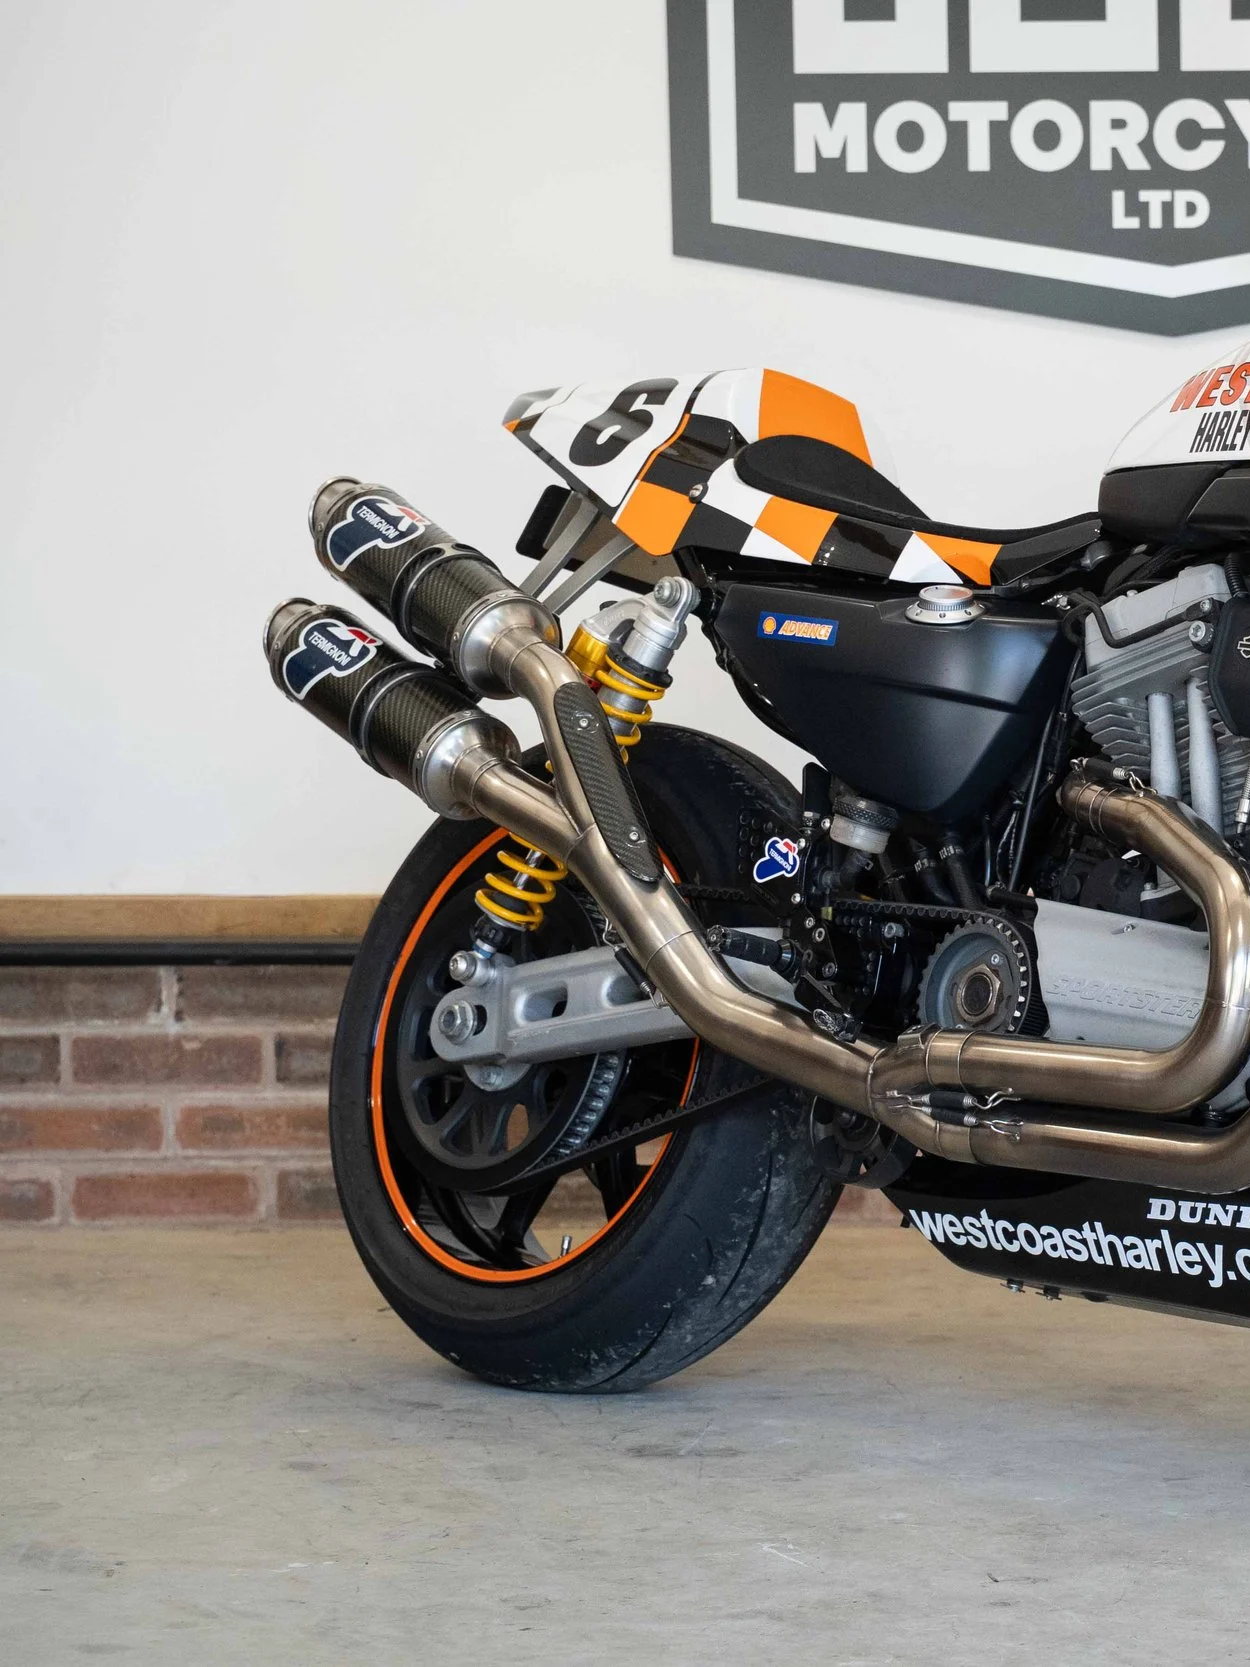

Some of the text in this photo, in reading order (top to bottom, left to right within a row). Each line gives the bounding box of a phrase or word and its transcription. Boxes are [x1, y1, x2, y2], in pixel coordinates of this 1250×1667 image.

[1112, 189, 1210, 229] LTD
[568, 377, 679, 467] 6
[356, 505, 401, 540] TERMIGNONI
[308, 631, 352, 667] TERMIGNONI
[778, 619, 834, 641] ADVANCE
[1046, 974, 1204, 1020] SPORTSTER
